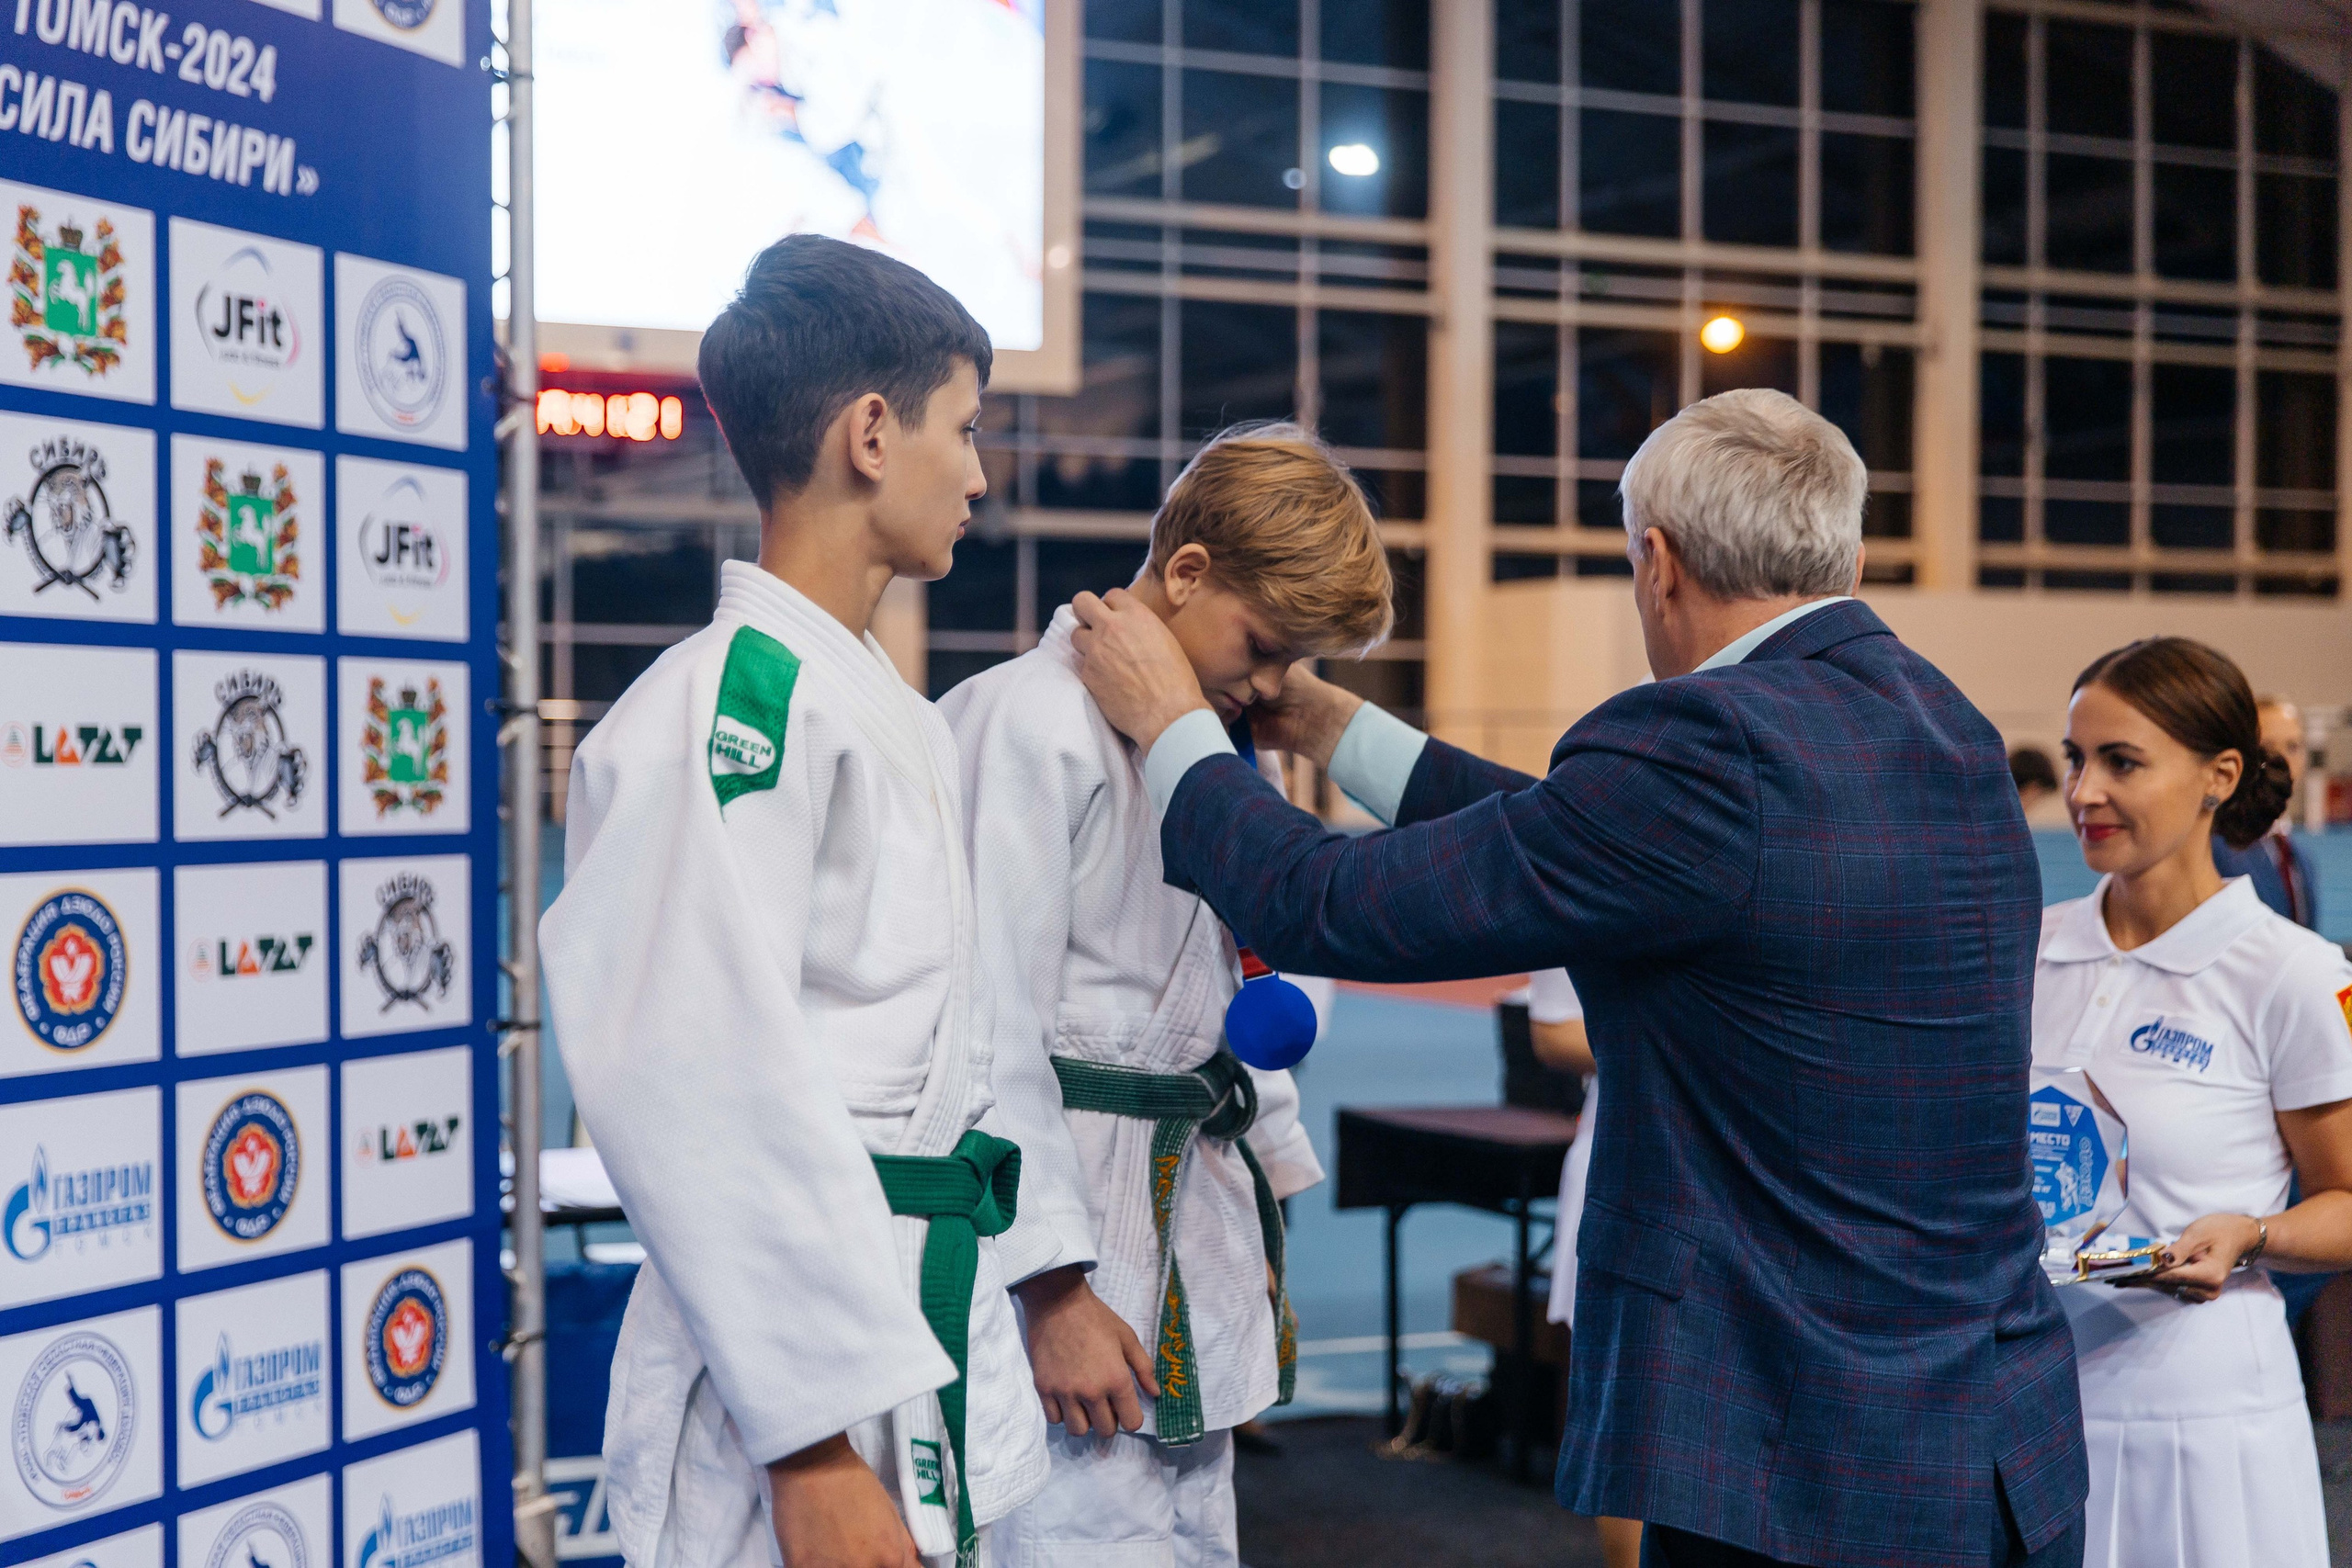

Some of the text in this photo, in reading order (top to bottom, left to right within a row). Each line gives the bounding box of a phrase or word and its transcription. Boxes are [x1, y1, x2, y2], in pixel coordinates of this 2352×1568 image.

[0, 63, 319, 197] СИЛА СИБИРИ»
[212, 293, 282, 348] JFit
[374, 522, 434, 569] JFit
[715, 731, 772, 757] GREEN
[715, 744, 761, 770] HILL
[52, 1162, 152, 1211] ГАЗПРОМ
[233, 1342, 321, 1392] ГАЗПРОМ
[914, 1458, 940, 1470] GREE
